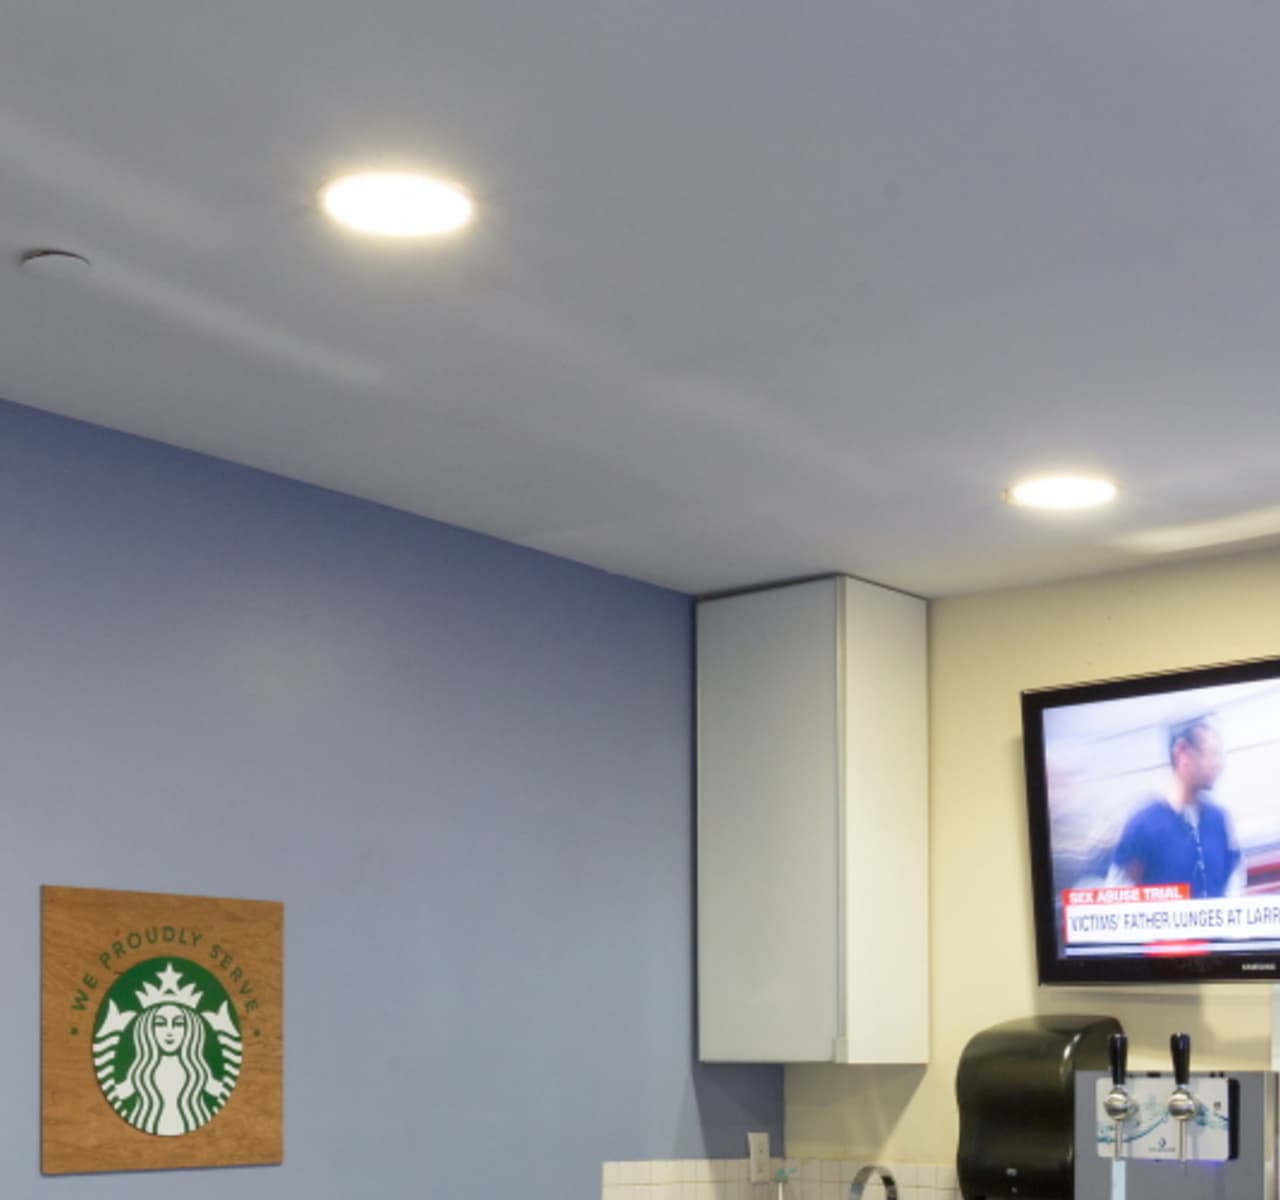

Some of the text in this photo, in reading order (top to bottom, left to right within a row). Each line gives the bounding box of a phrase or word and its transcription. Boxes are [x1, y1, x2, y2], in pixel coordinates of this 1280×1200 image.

[1068, 886, 1184, 905] SEX ABUSE TRIAL
[1070, 913, 1120, 932] VICTIMS'
[1123, 911, 1168, 930] FATHER
[1173, 908, 1225, 927] LUNGES
[1228, 908, 1242, 926] AT
[71, 925, 261, 1014] WE PROUDLY SERVE
